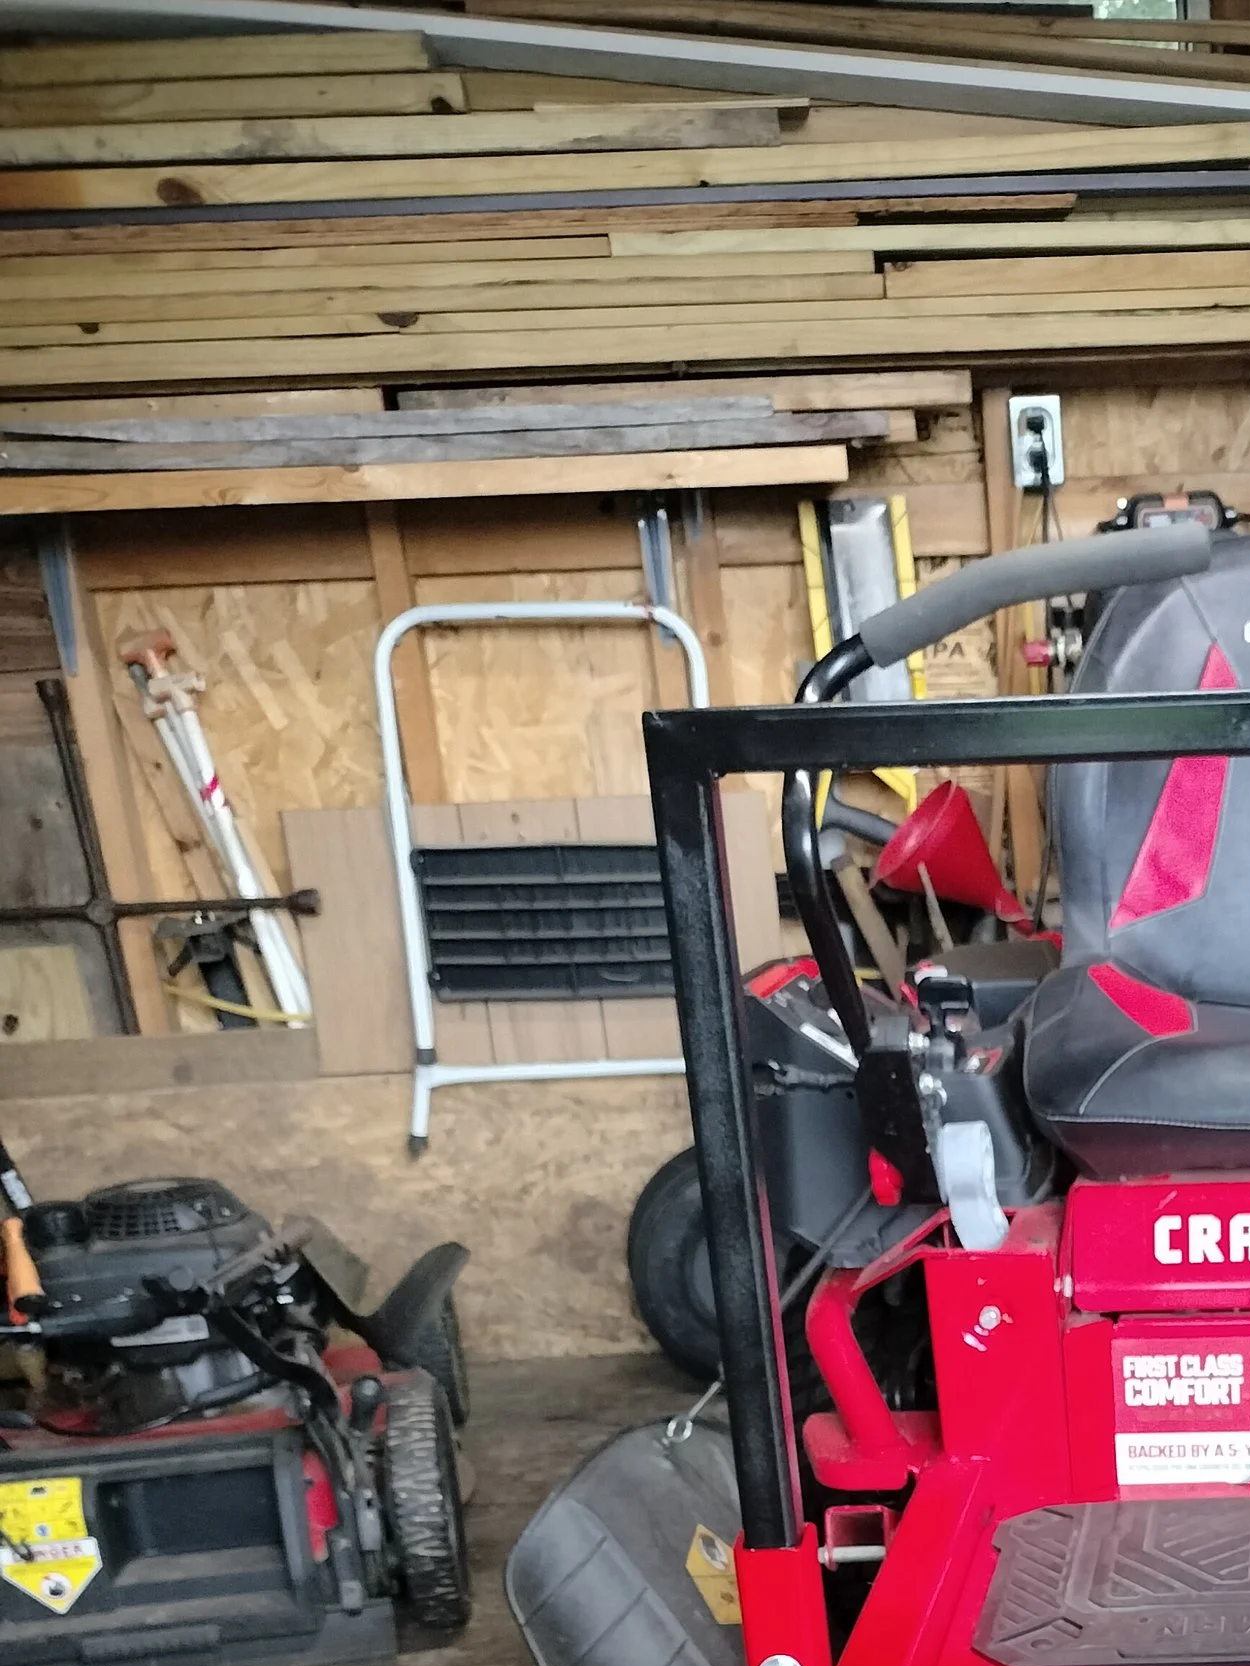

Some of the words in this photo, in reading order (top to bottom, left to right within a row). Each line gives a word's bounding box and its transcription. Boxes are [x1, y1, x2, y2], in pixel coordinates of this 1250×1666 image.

[1122, 1354, 1179, 1378] FIRST
[1180, 1353, 1244, 1377] CLASS
[1124, 1377, 1245, 1407] COMFORT
[1128, 1444, 1187, 1458] BACKED
[1191, 1444, 1209, 1458] BY
[1214, 1443, 1224, 1457] A
